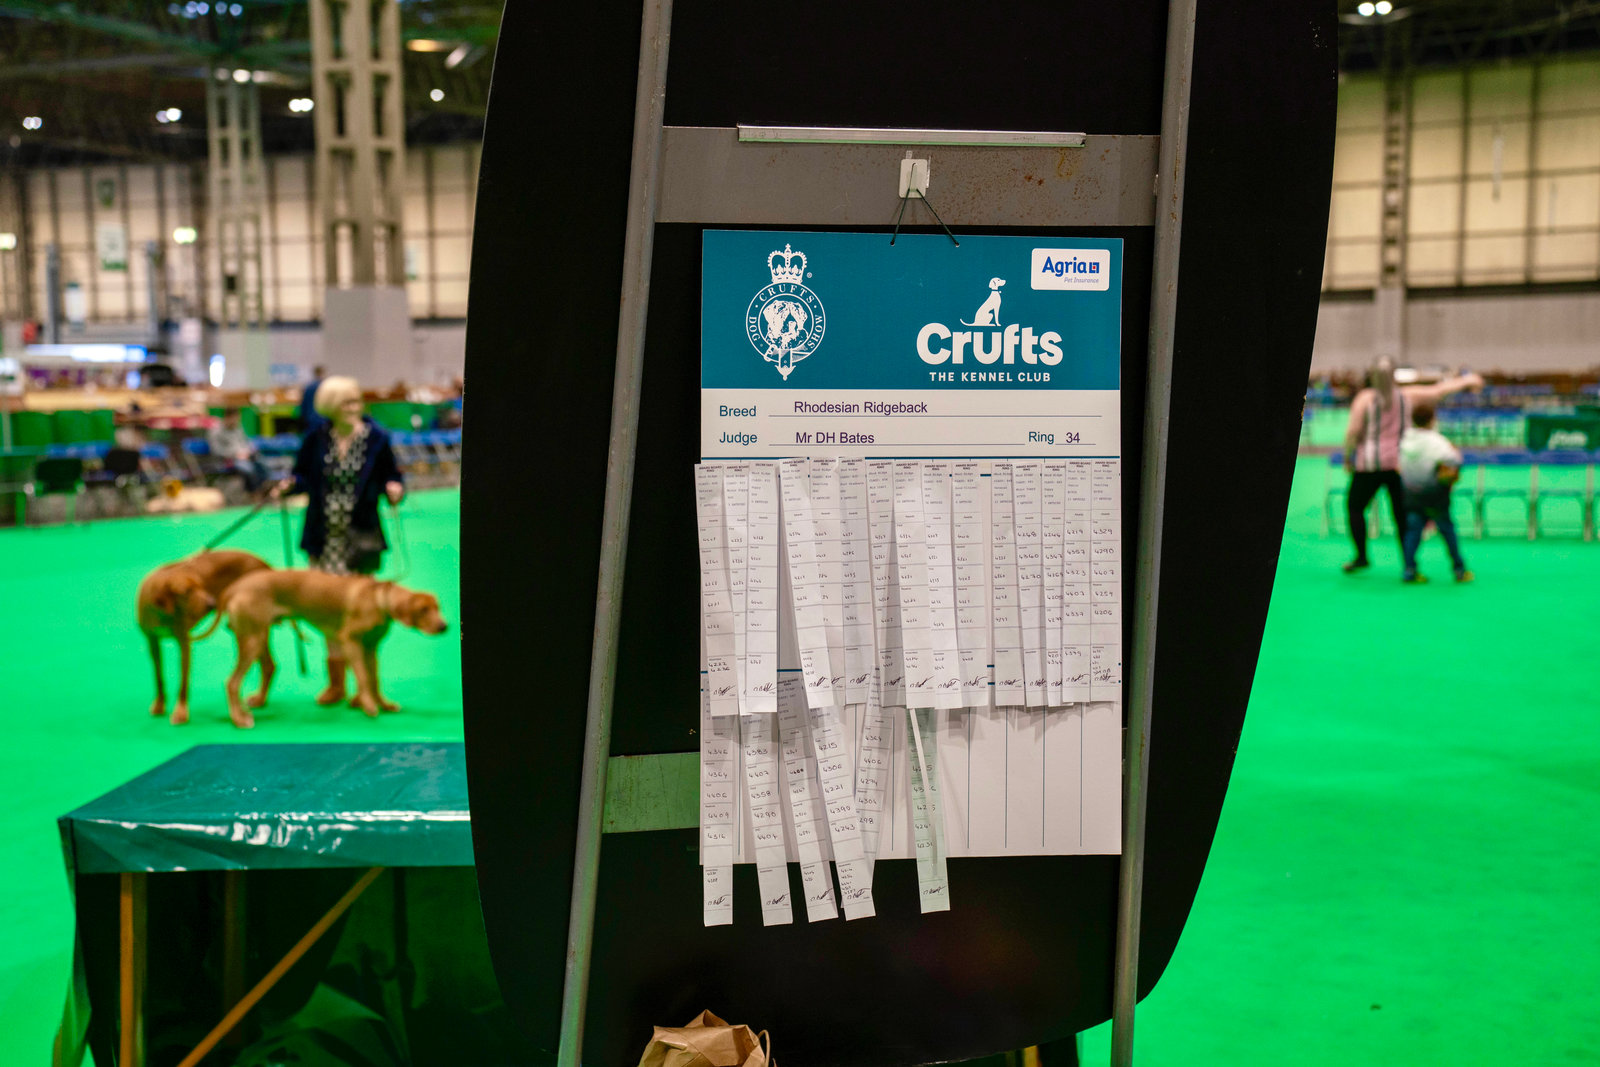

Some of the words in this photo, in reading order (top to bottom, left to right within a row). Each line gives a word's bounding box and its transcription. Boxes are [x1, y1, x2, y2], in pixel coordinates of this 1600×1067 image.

[1042, 256, 1087, 277] Agria
[759, 284, 815, 304] CRUFTS
[748, 316, 760, 342] DOG
[808, 314, 823, 349] SHOW
[916, 322, 1063, 366] Crufts
[930, 372, 955, 382] THE
[961, 372, 1013, 382] KENNEL
[1018, 372, 1051, 382] CLUB
[719, 405, 756, 417] Breed
[794, 401, 860, 414] Rhodesian
[864, 401, 928, 417] Ridgeback
[719, 432, 758, 445] Judge
[796, 432, 812, 444] Mr
[816, 432, 836, 444] DH
[840, 432, 875, 444] Bates
[1028, 431, 1055, 445] Ring
[1066, 433, 1080, 444] 34
